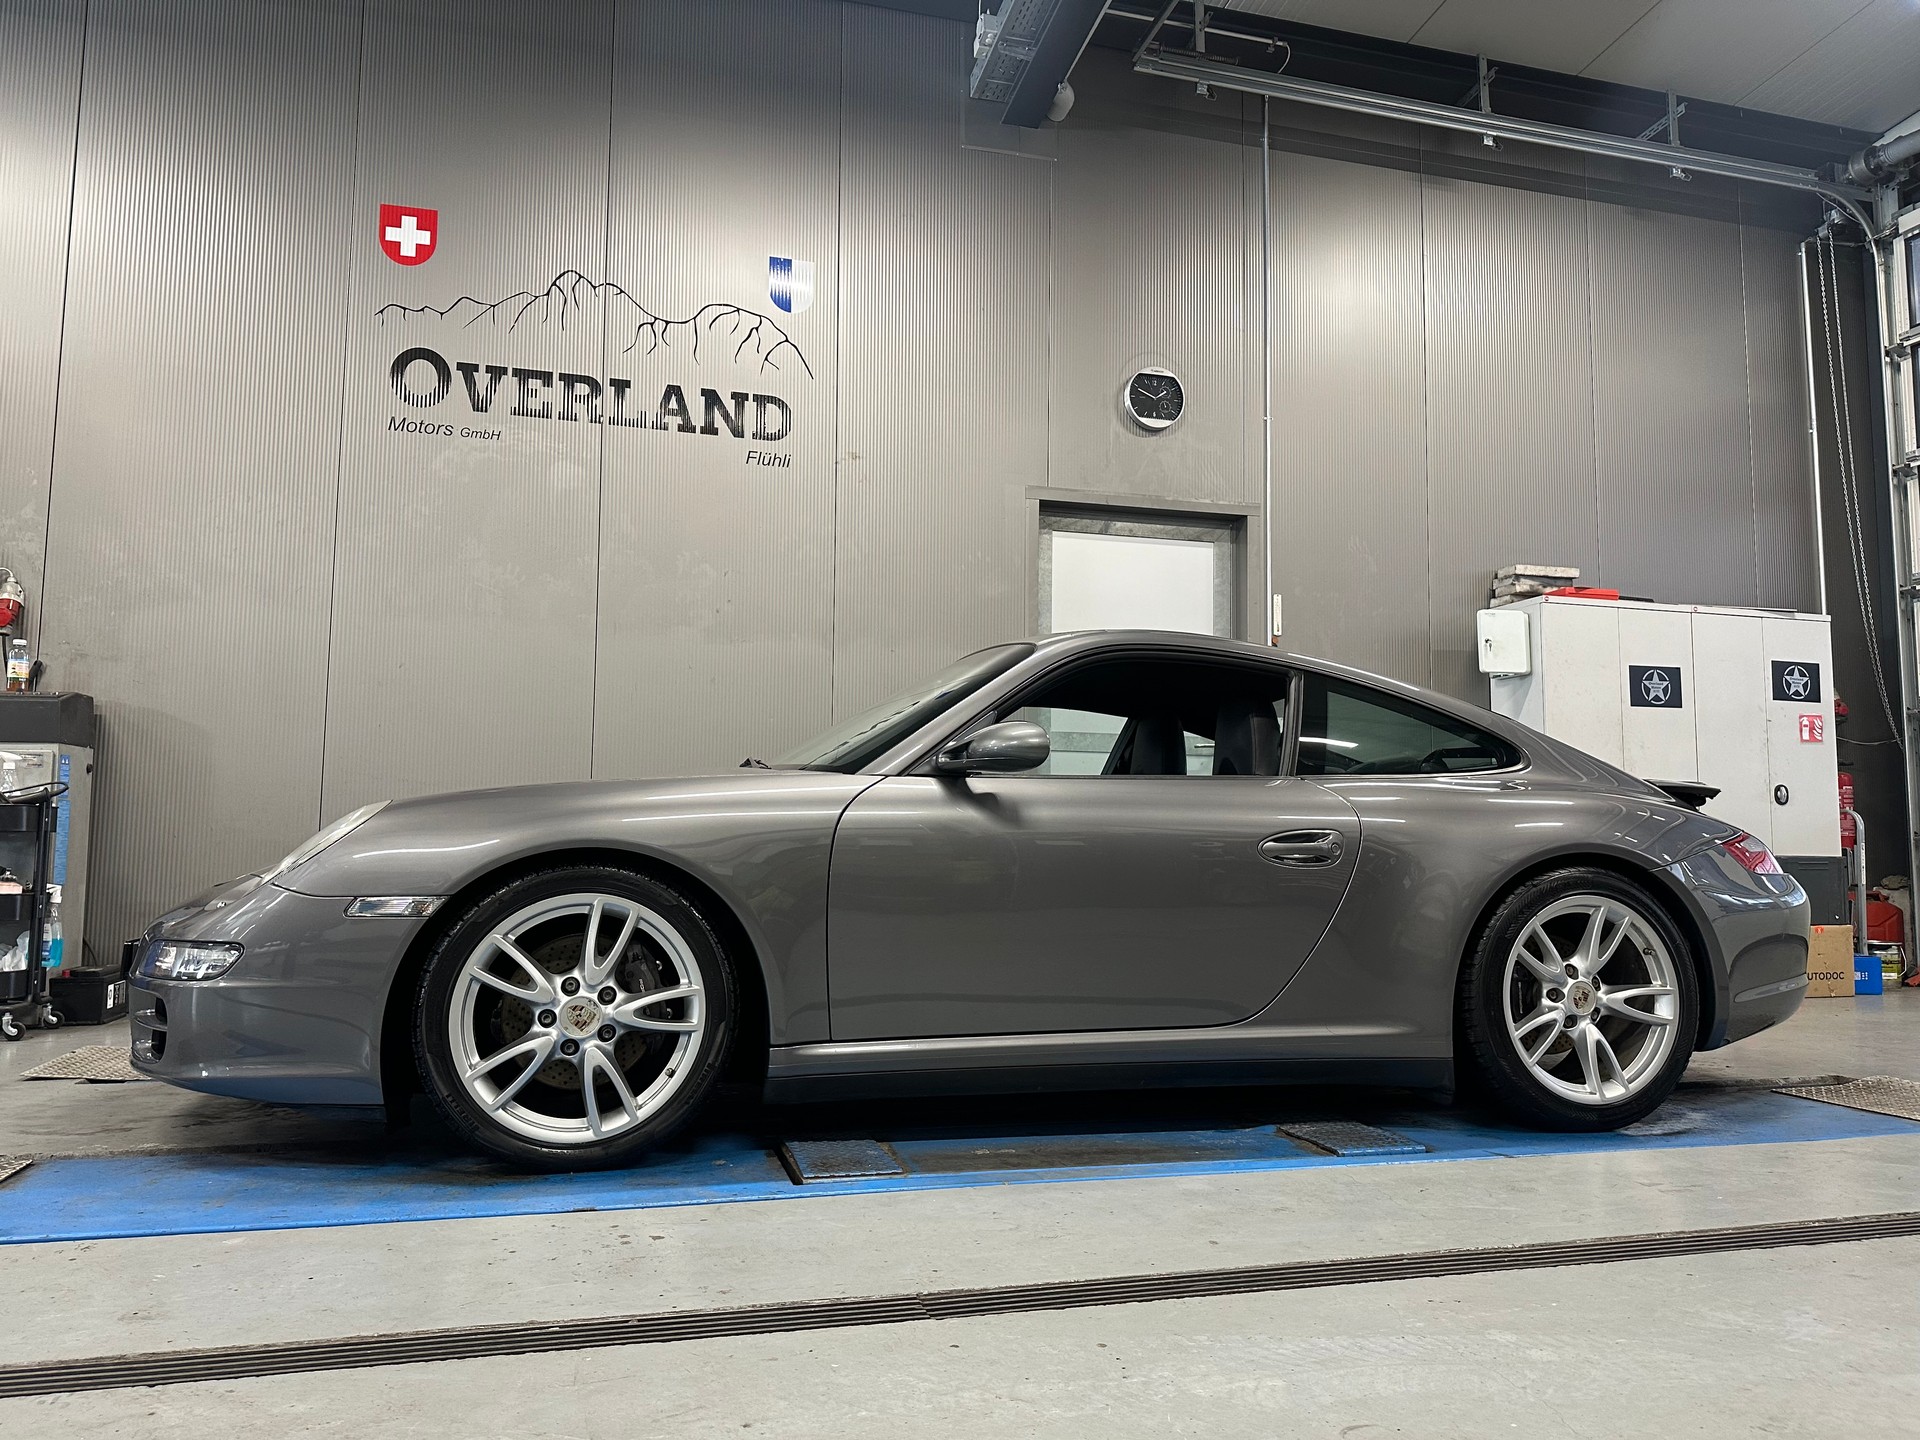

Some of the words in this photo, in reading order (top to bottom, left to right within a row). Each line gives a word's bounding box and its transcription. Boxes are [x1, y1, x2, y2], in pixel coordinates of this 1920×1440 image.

[389, 347, 792, 442] OVERLAND
[388, 416, 454, 437] Motors
[460, 427, 501, 441] GmbH
[746, 450, 792, 469] Flühli
[1807, 971, 1845, 981] UTODOC
